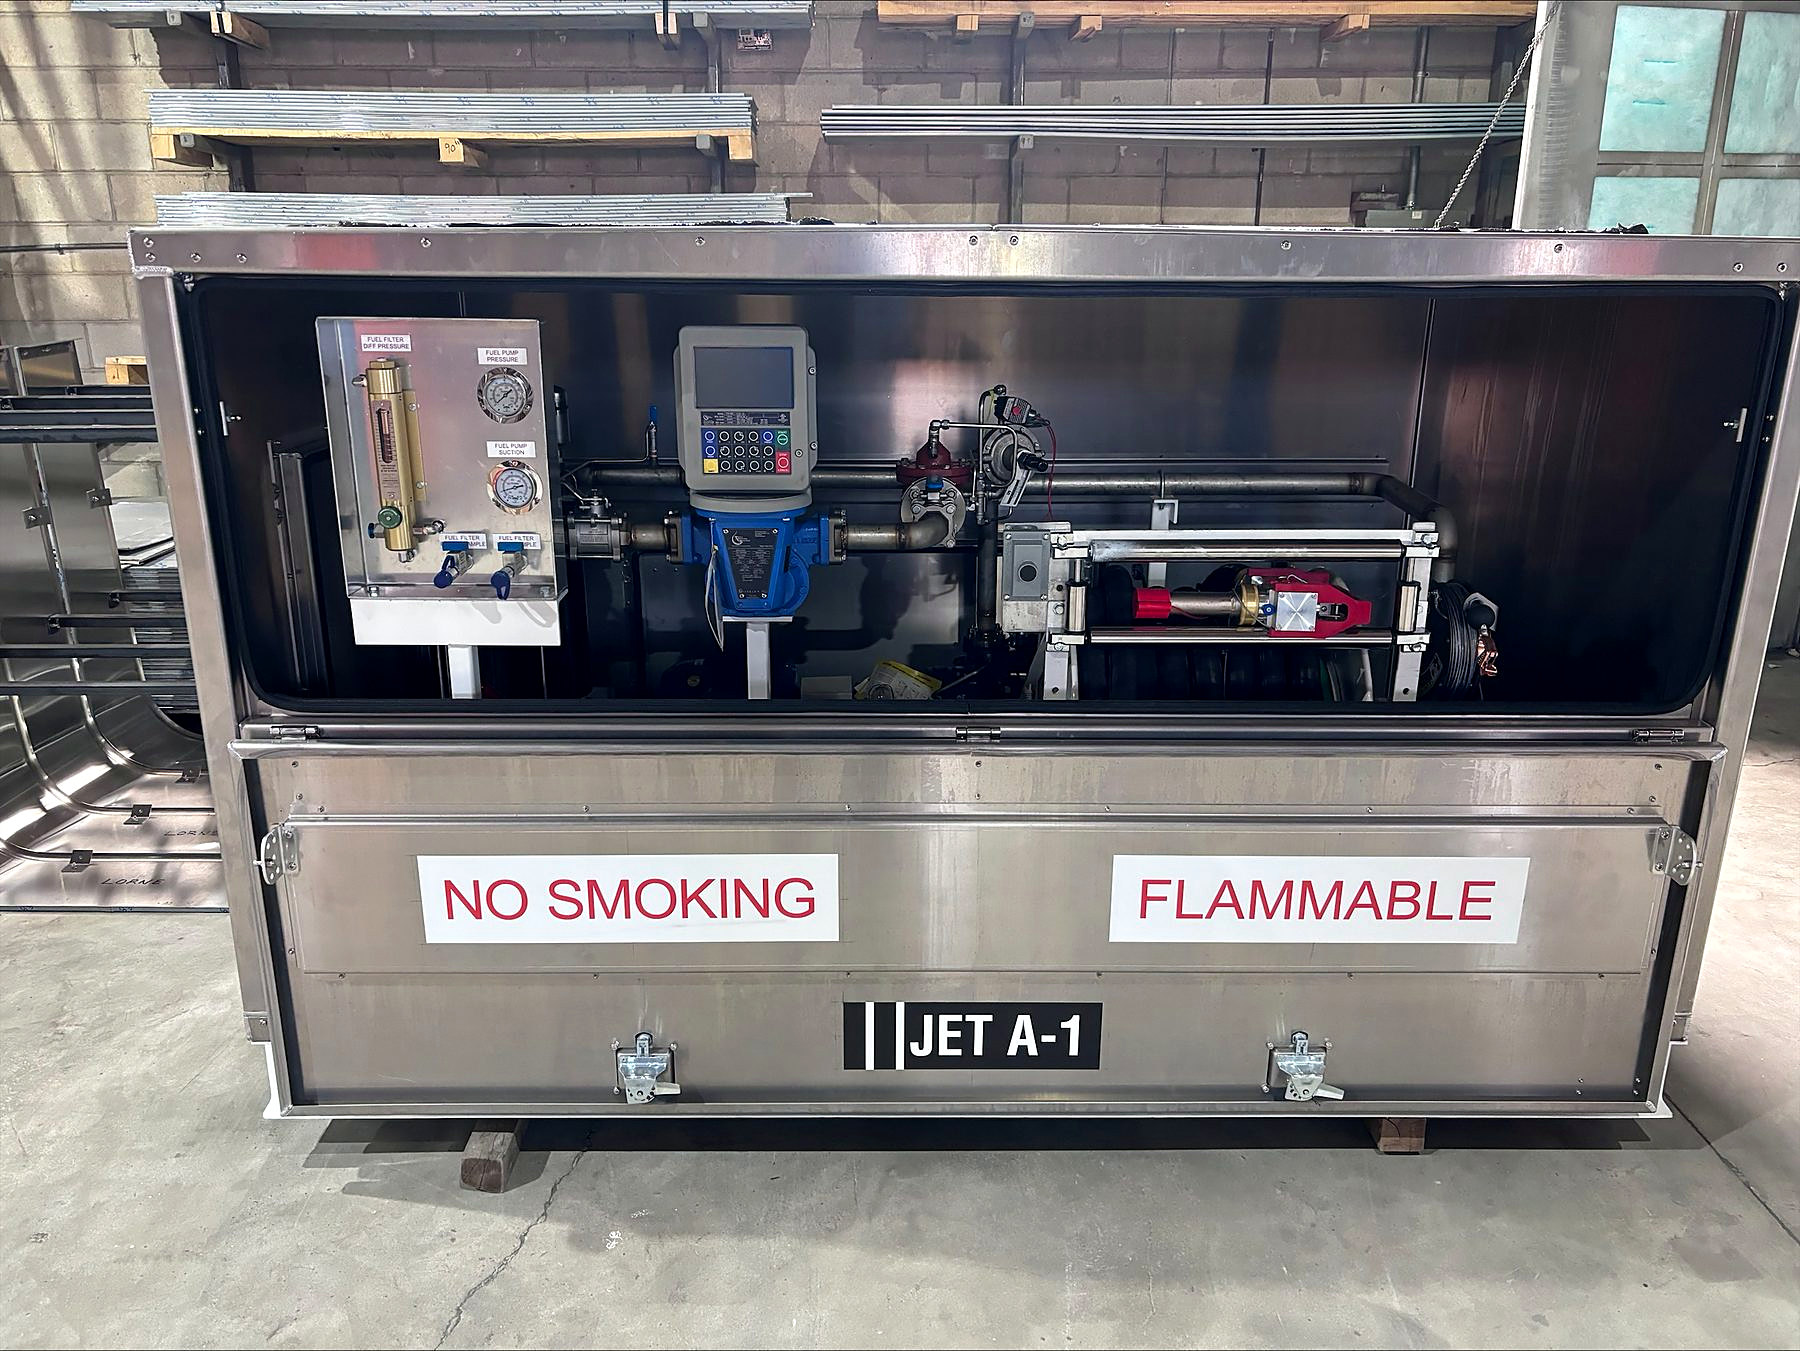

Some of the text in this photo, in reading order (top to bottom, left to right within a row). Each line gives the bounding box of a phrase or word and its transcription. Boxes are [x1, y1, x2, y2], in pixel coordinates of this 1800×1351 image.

[443, 877, 816, 921] NO SMOKING
[1139, 879, 1496, 921] FLAMMABLE
[909, 1014, 1081, 1057] JET A-1
